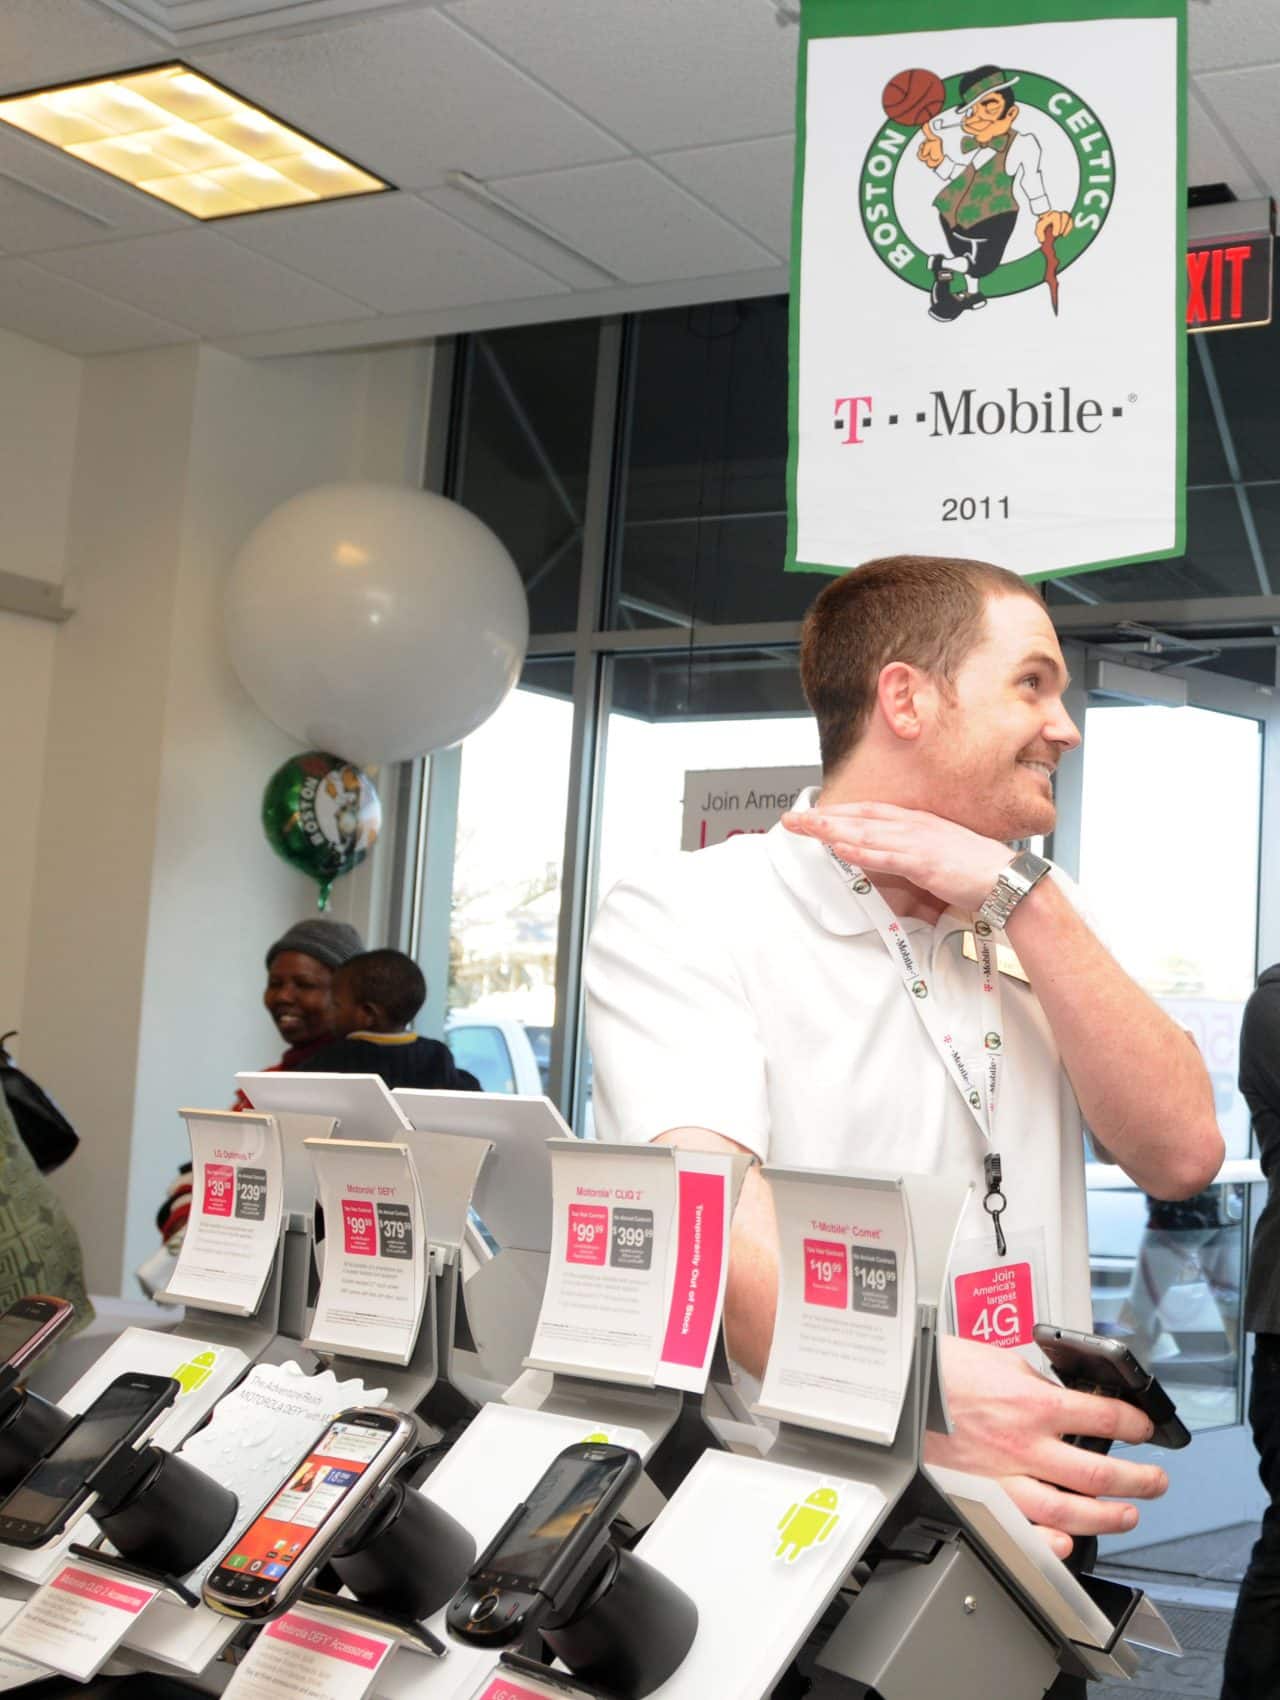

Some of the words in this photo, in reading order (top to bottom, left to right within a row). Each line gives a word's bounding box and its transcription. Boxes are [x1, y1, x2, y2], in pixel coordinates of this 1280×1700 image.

[1048, 92, 1111, 230] CELTICS
[866, 128, 915, 269] BOSTON
[1186, 246, 1251, 323] XIT
[941, 496, 1010, 521] 2011
[701, 792, 740, 812] Join
[576, 1186, 610, 1198] Motorola
[690, 1203, 704, 1266] Temporarily
[852, 1226, 881, 1240] Comet
[689, 1268, 700, 1288] Out
[991, 1270, 1016, 1283] Join
[687, 1290, 696, 1302] of
[972, 1281, 1016, 1297] America's
[986, 1291, 1017, 1305] largest
[681, 1303, 695, 1335] Stock
[971, 1302, 1020, 1341] 4G
[277, 1620, 307, 1640] Motorola
[331, 1638, 375, 1661] Accessories
